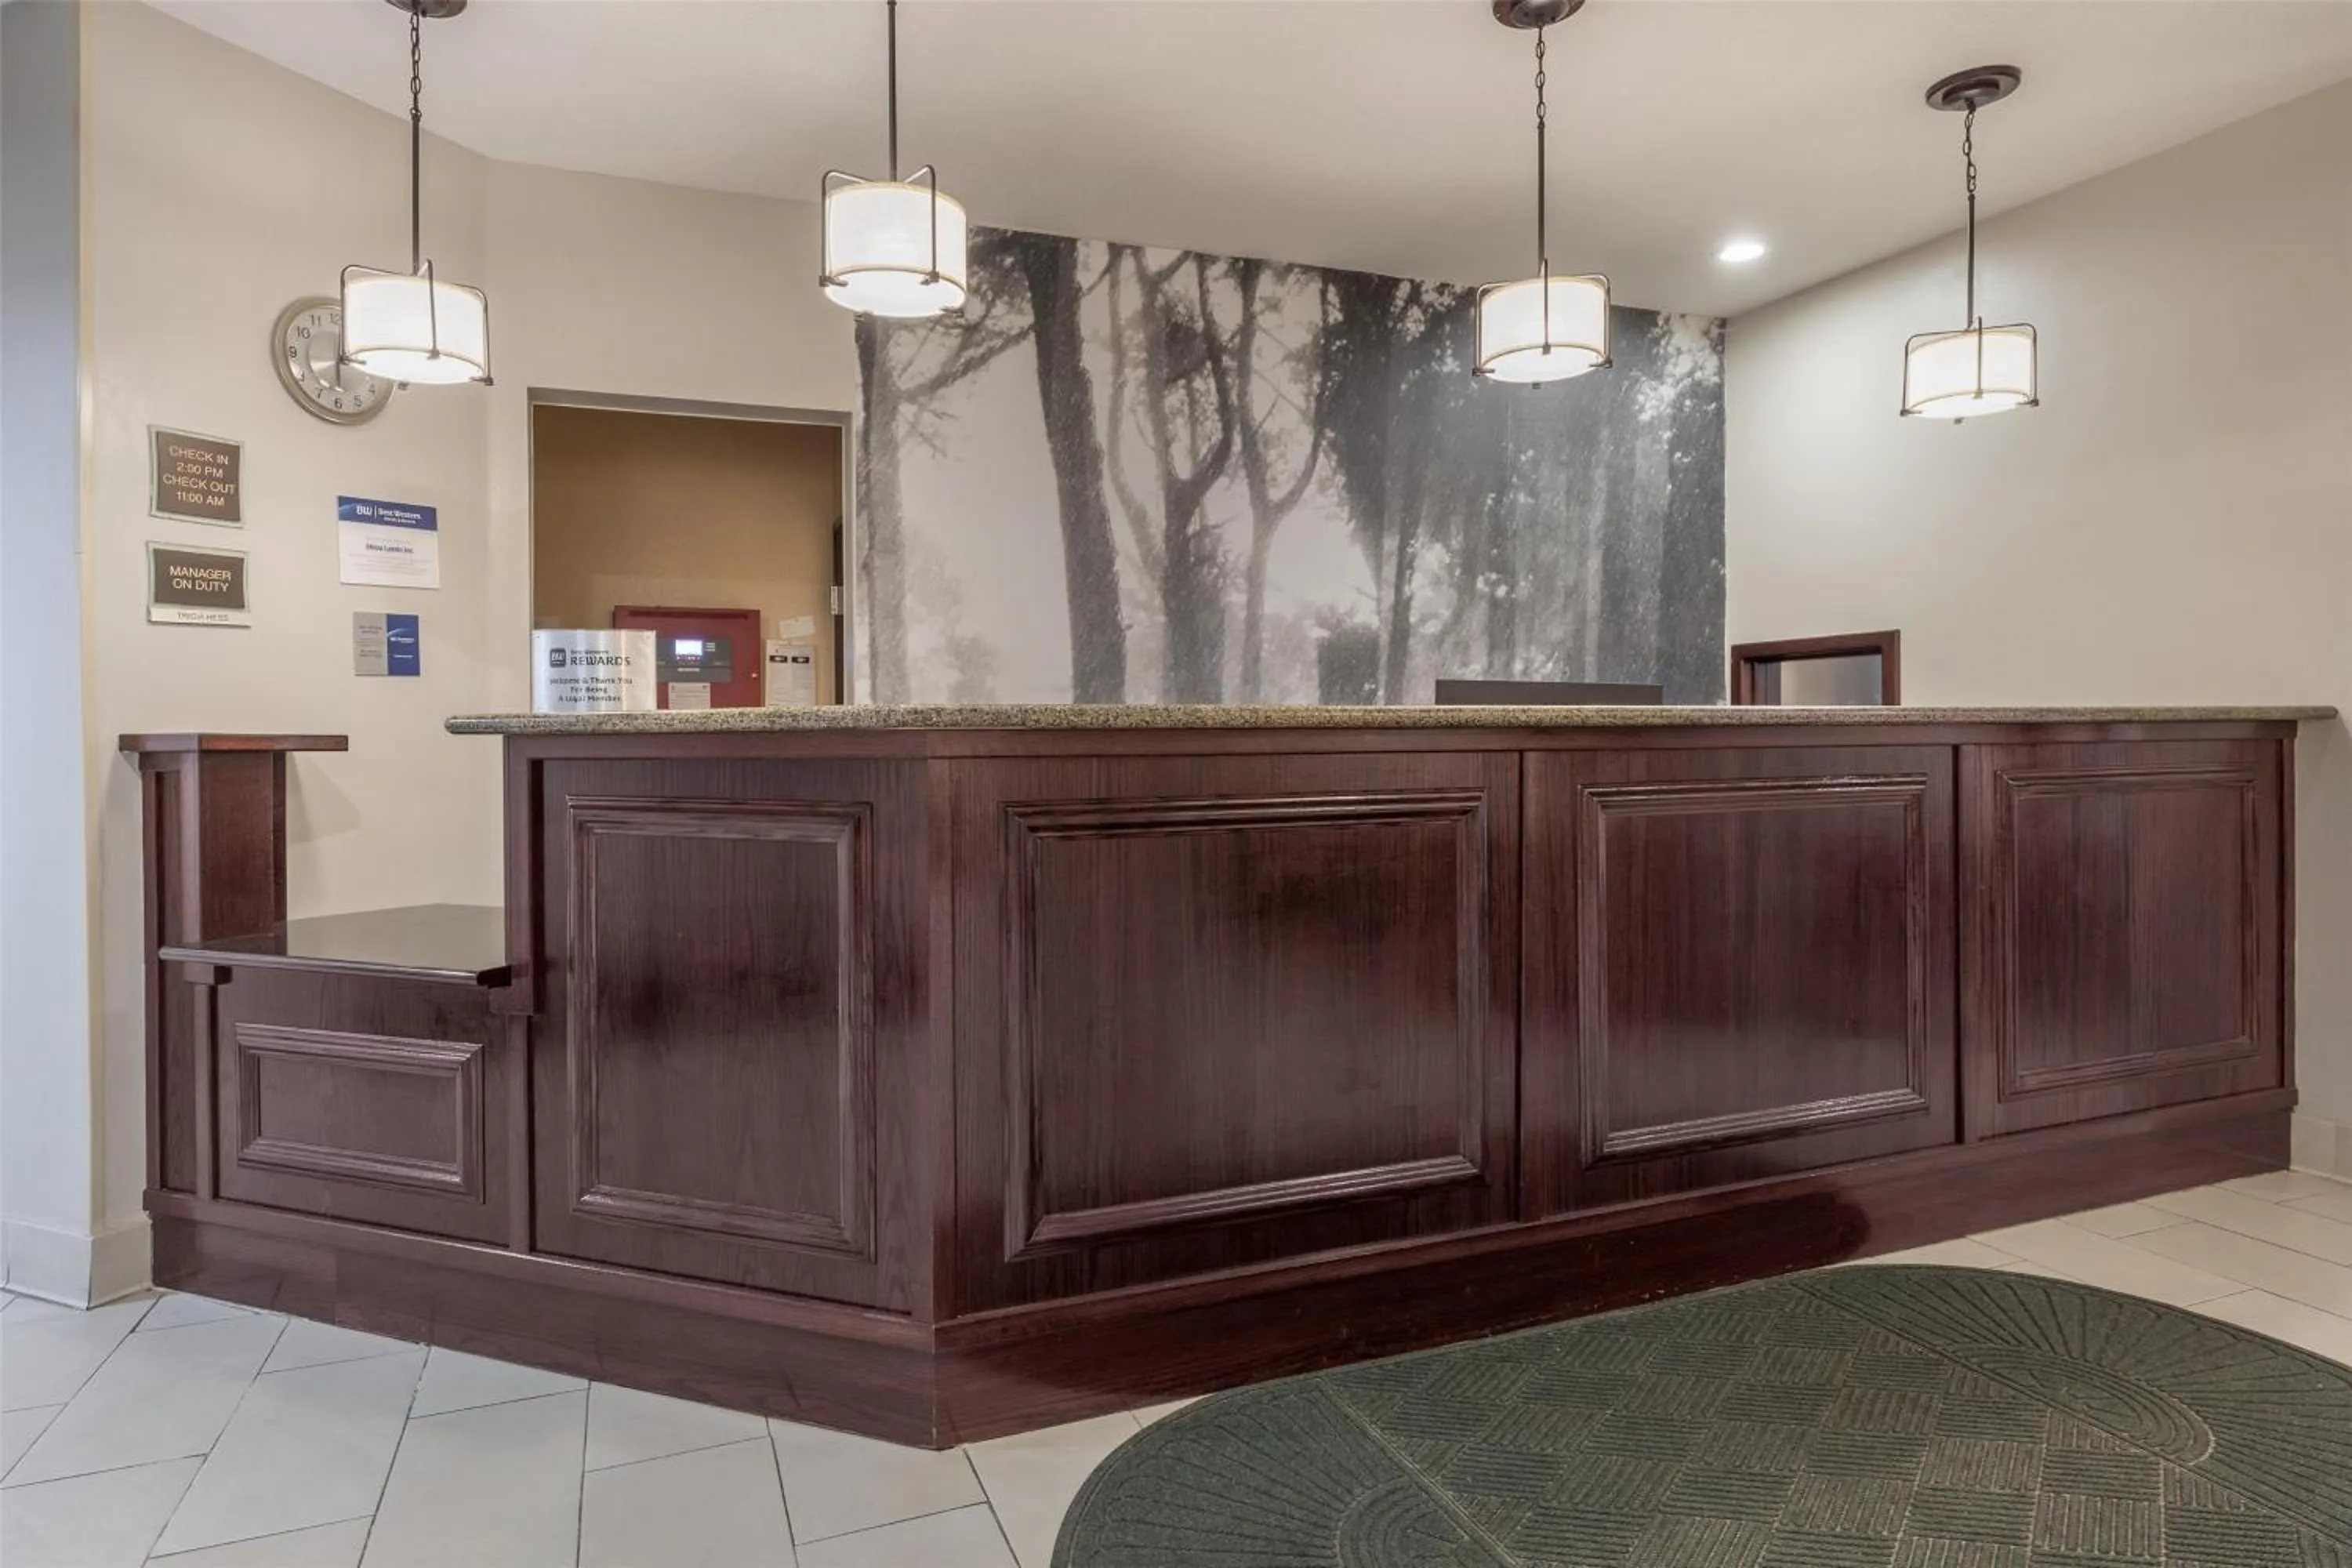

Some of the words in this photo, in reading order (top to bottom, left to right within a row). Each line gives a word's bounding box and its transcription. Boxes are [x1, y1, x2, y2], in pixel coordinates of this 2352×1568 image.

[310, 314, 321, 327] 11
[296, 326, 310, 339] 10
[289, 346, 297, 358] 9
[315, 387, 324, 398] 7
[334, 397, 343, 408] 6
[354, 394, 362, 407] 5
[169, 445, 214, 463] CHECK
[216, 454, 229, 465] IN
[176, 462, 201, 474] 2:00
[205, 466, 223, 478] PM
[162, 473, 208, 490] CHECK
[209, 480, 235, 495] OUT
[176, 492, 203, 504] 11:00
[205, 495, 225, 506] AM
[169, 564, 231, 581] MANAGER
[172, 578, 192, 590] ON
[195, 580, 230, 593] DUTY
[570, 656, 631, 666] REWARDS
